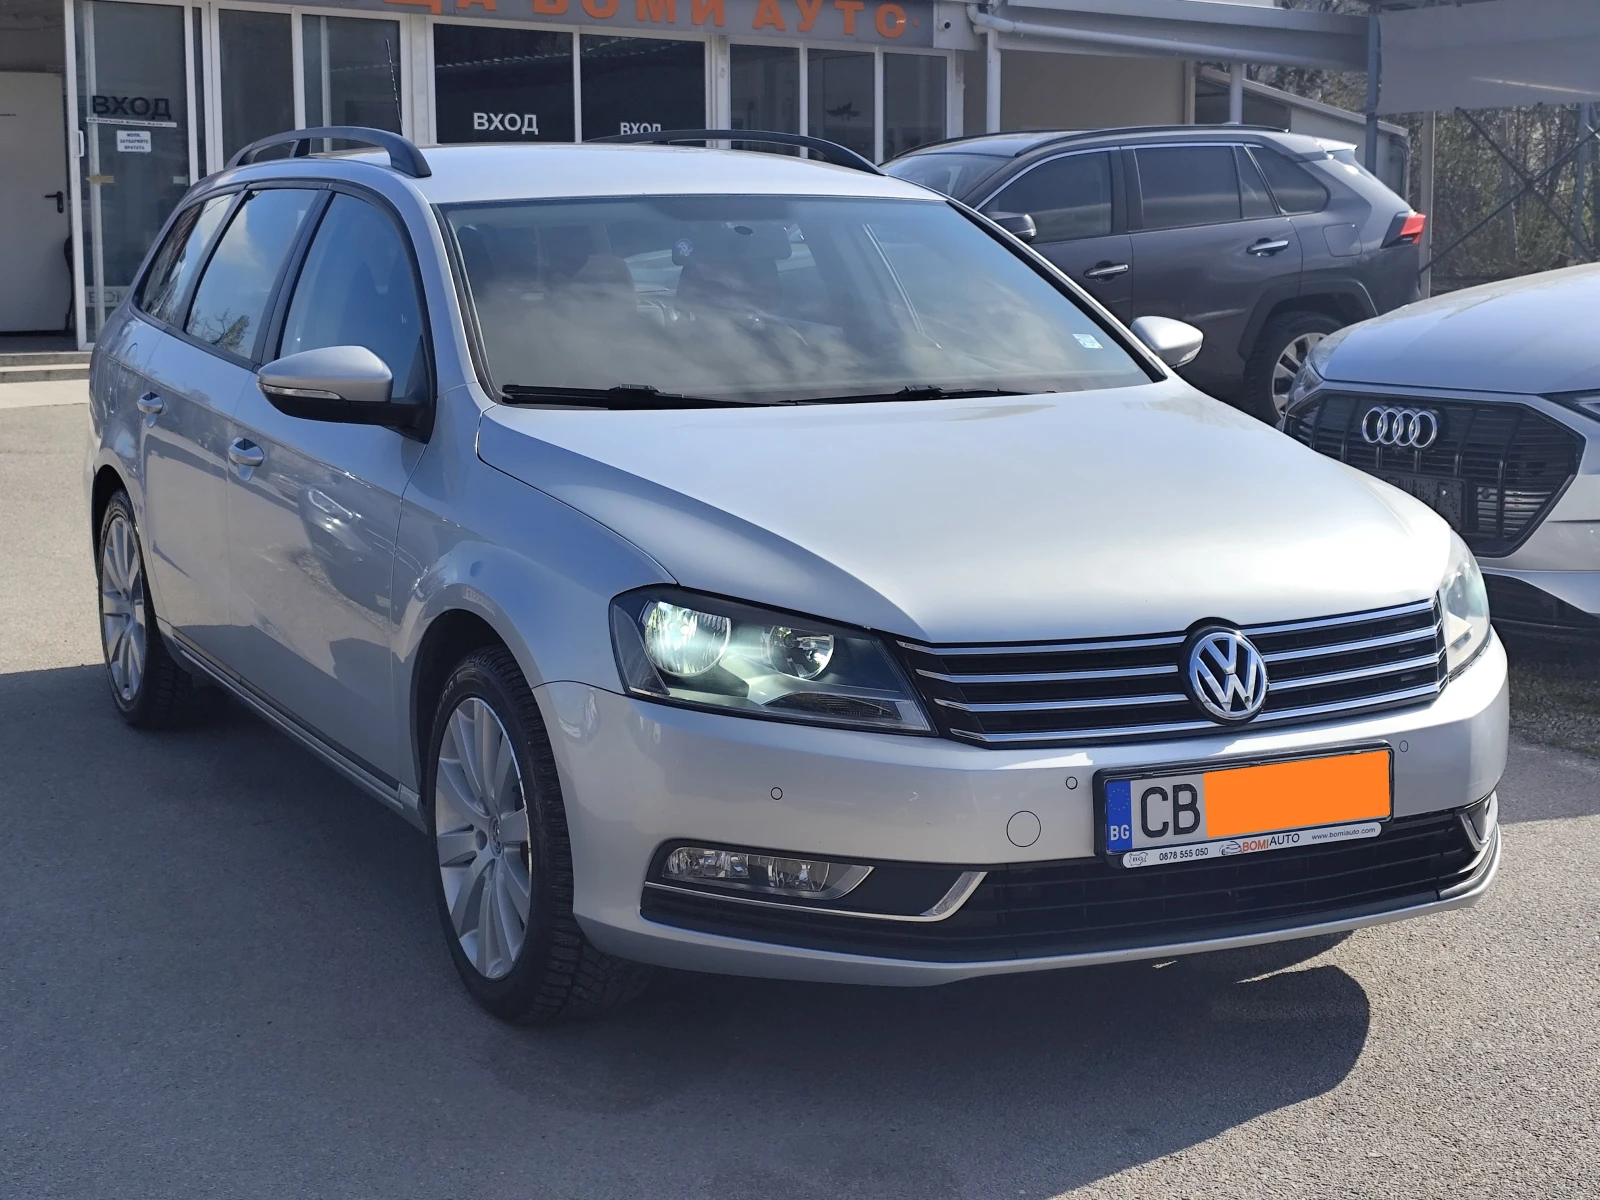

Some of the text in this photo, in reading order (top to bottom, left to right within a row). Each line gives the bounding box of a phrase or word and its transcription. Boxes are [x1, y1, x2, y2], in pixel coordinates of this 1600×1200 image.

[752, 0, 907, 38] АУТО
[92, 96, 171, 120] ВХОД
[473, 112, 539, 135] ВХОД
[1141, 783, 1201, 839] CB
[1110, 824, 1130, 841] BG
[1311, 826, 1376, 841] www.bomiauto.com
[1159, 847, 1209, 861] 0878 555 050
